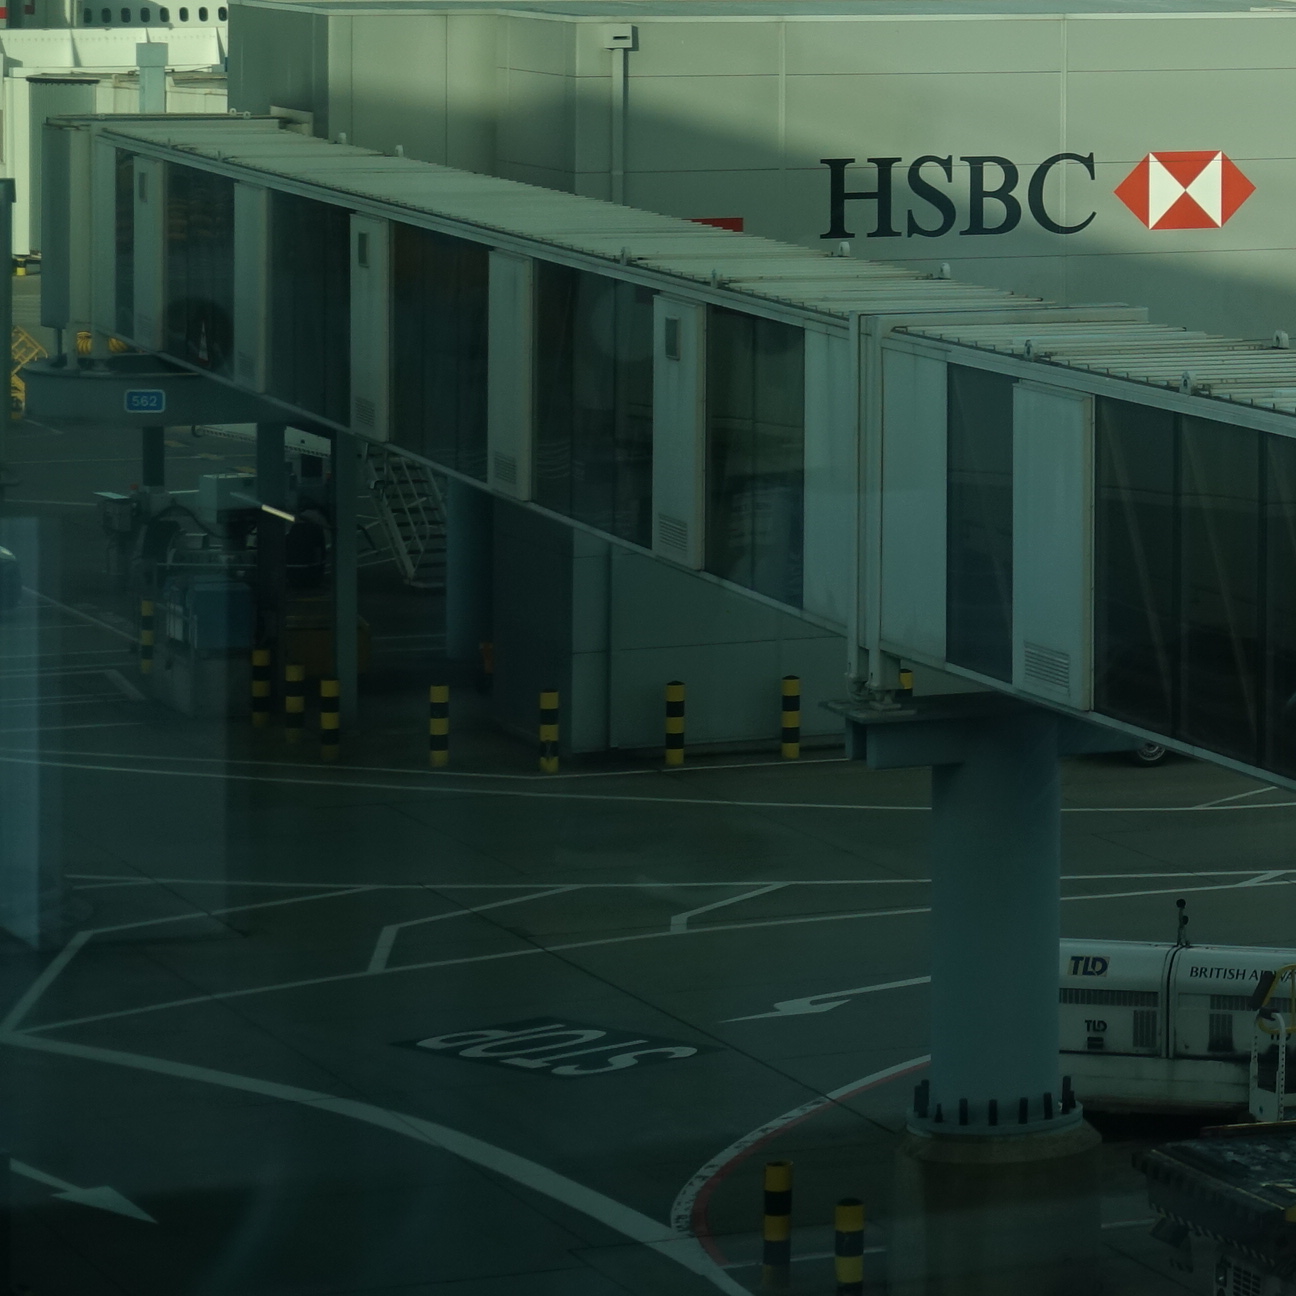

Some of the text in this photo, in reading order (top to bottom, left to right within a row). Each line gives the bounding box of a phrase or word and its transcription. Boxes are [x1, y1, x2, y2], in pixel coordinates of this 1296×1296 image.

[820, 152, 1097, 239] HSBC
[131, 395, 157, 407] 562
[1070, 956, 1108, 976] TLD
[1190, 966, 1246, 980] BRITISH
[1084, 1019, 1108, 1032] TLD
[415, 1023, 698, 1077] STOP
